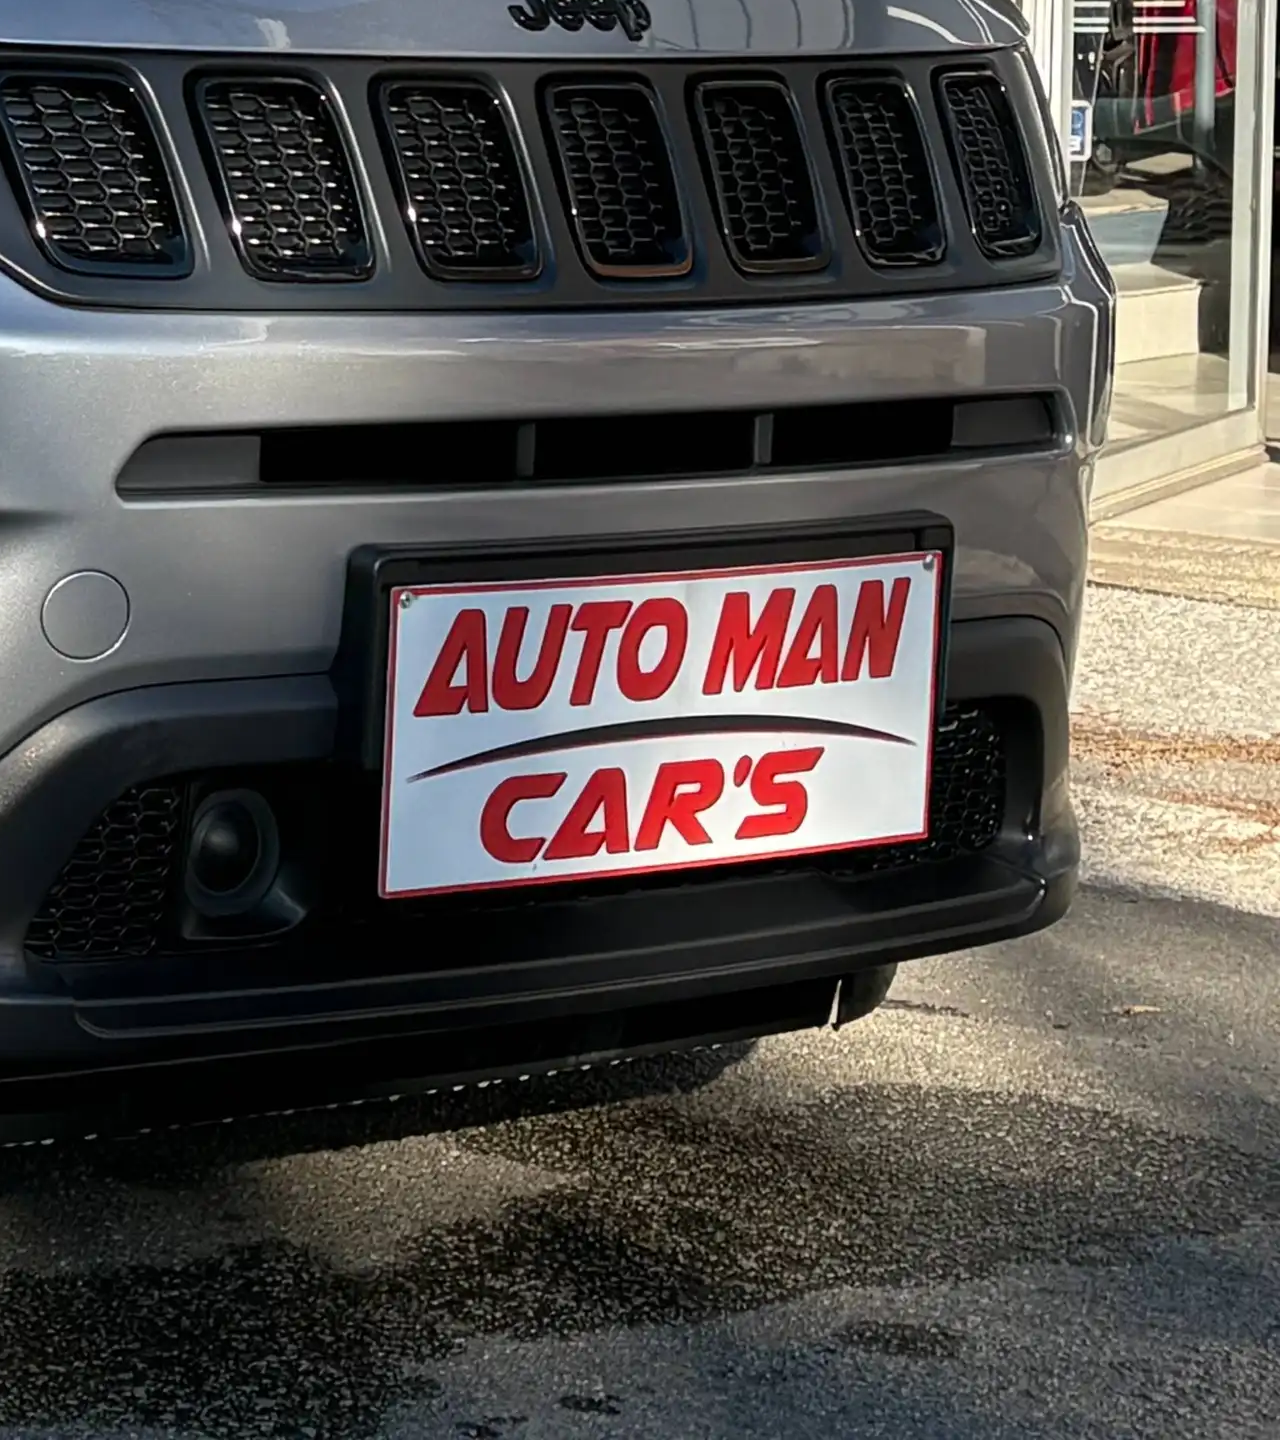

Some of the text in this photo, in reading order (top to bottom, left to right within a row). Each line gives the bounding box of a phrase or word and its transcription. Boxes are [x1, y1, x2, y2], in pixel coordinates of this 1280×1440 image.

[412, 576, 911, 718] AUTO MAN
[478, 746, 825, 865] CAR'S
